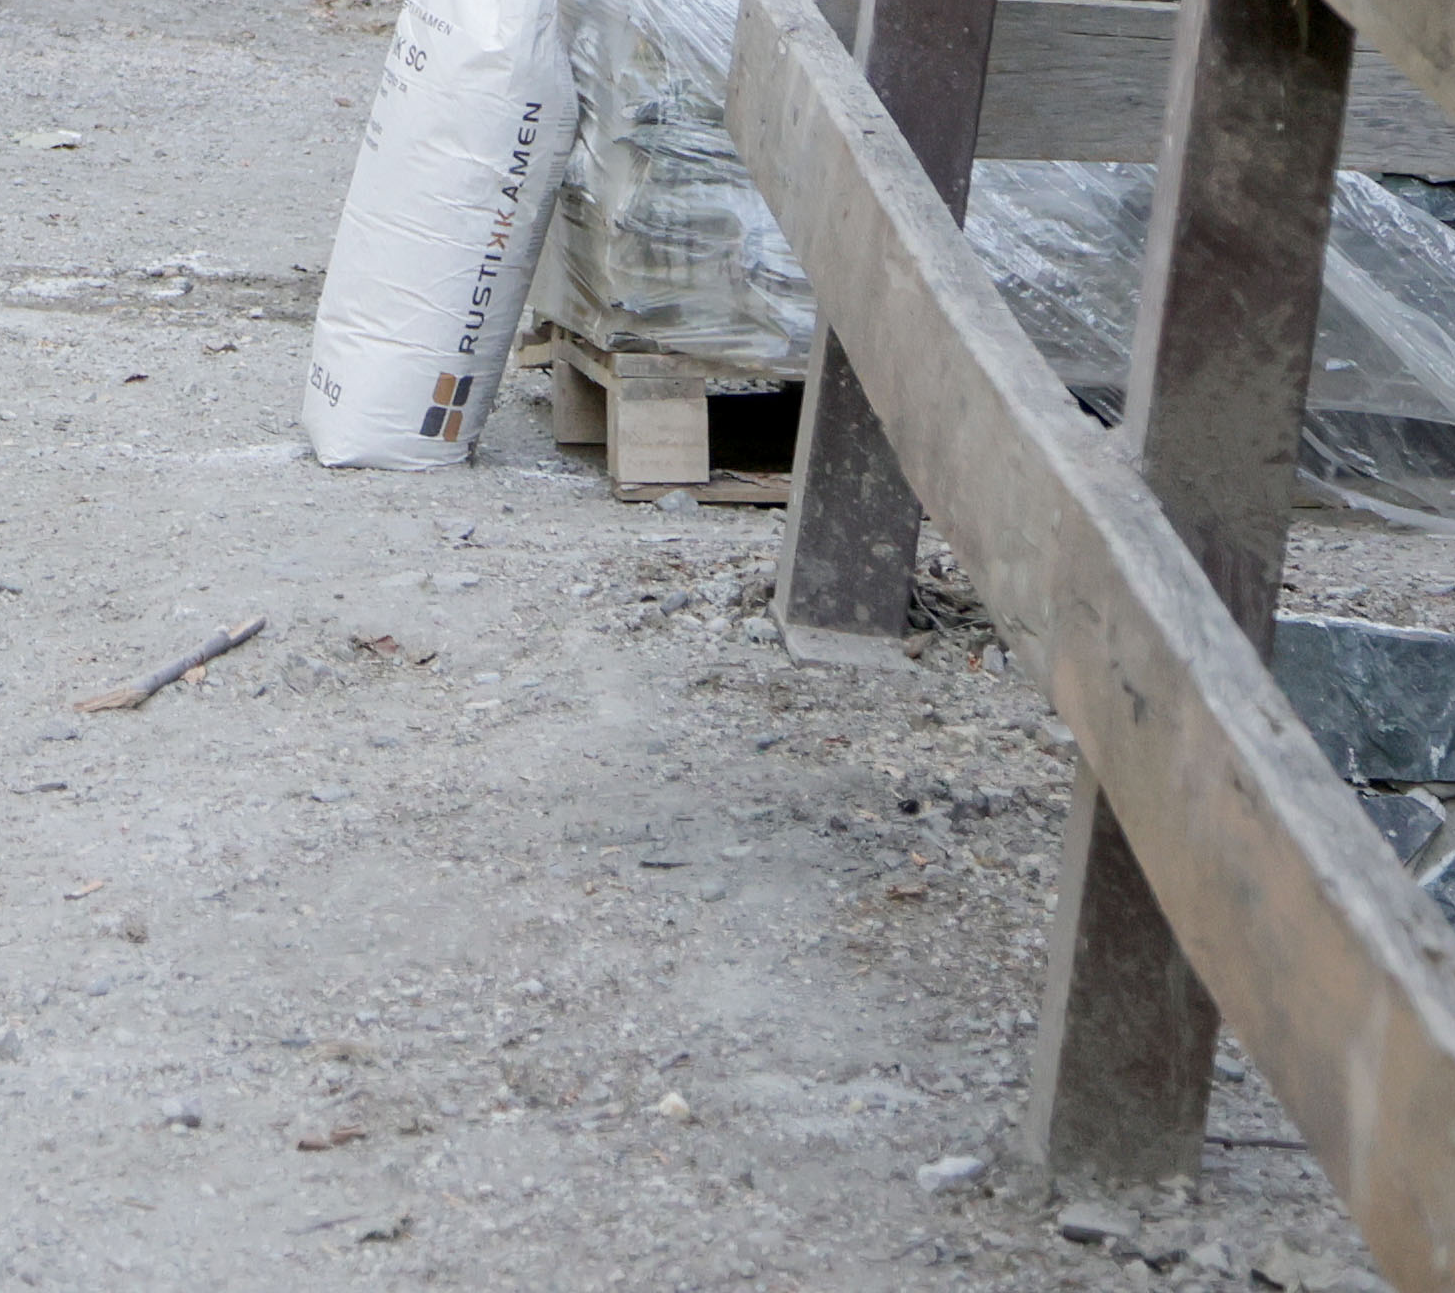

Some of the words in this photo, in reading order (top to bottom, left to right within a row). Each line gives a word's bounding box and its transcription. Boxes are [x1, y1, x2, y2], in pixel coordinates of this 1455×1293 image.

[405, 44, 427, 73] SC
[457, 101, 544, 356] RUSTIKKAMEN
[323, 370, 343, 408] kg
